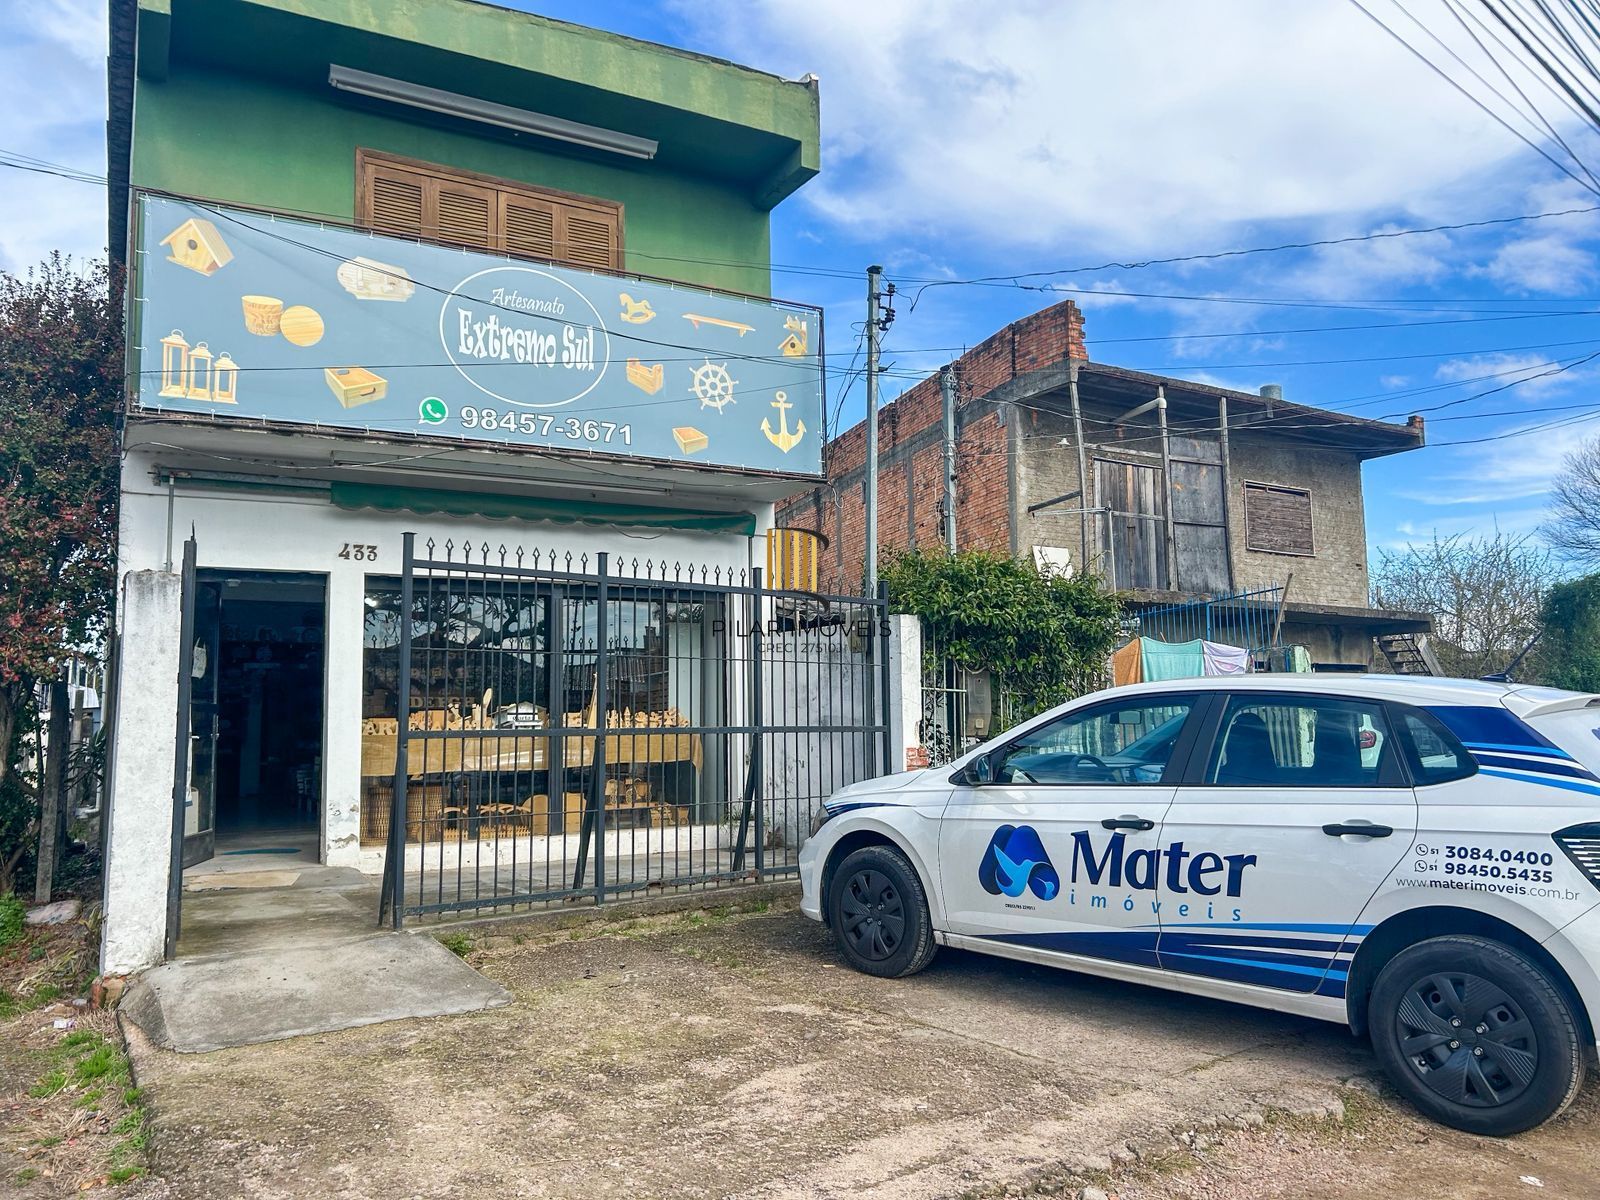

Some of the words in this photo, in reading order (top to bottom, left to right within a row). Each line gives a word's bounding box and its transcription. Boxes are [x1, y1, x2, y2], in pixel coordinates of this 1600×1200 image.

[489, 287, 566, 315] Artesanato
[457, 307, 557, 368] Extremo
[562, 324, 595, 372] Sul
[460, 405, 632, 445] 98457-3671
[338, 543, 378, 562] 433
[1070, 830, 1258, 897] Mater
[1445, 845, 1553, 866] 3084.0400
[1428, 863, 1439, 871] 51
[1444, 862, 1553, 883] 98450.5435
[1395, 877, 1580, 901] www.materimoveis.com.br
[1070, 889, 1242, 922] imóveis
